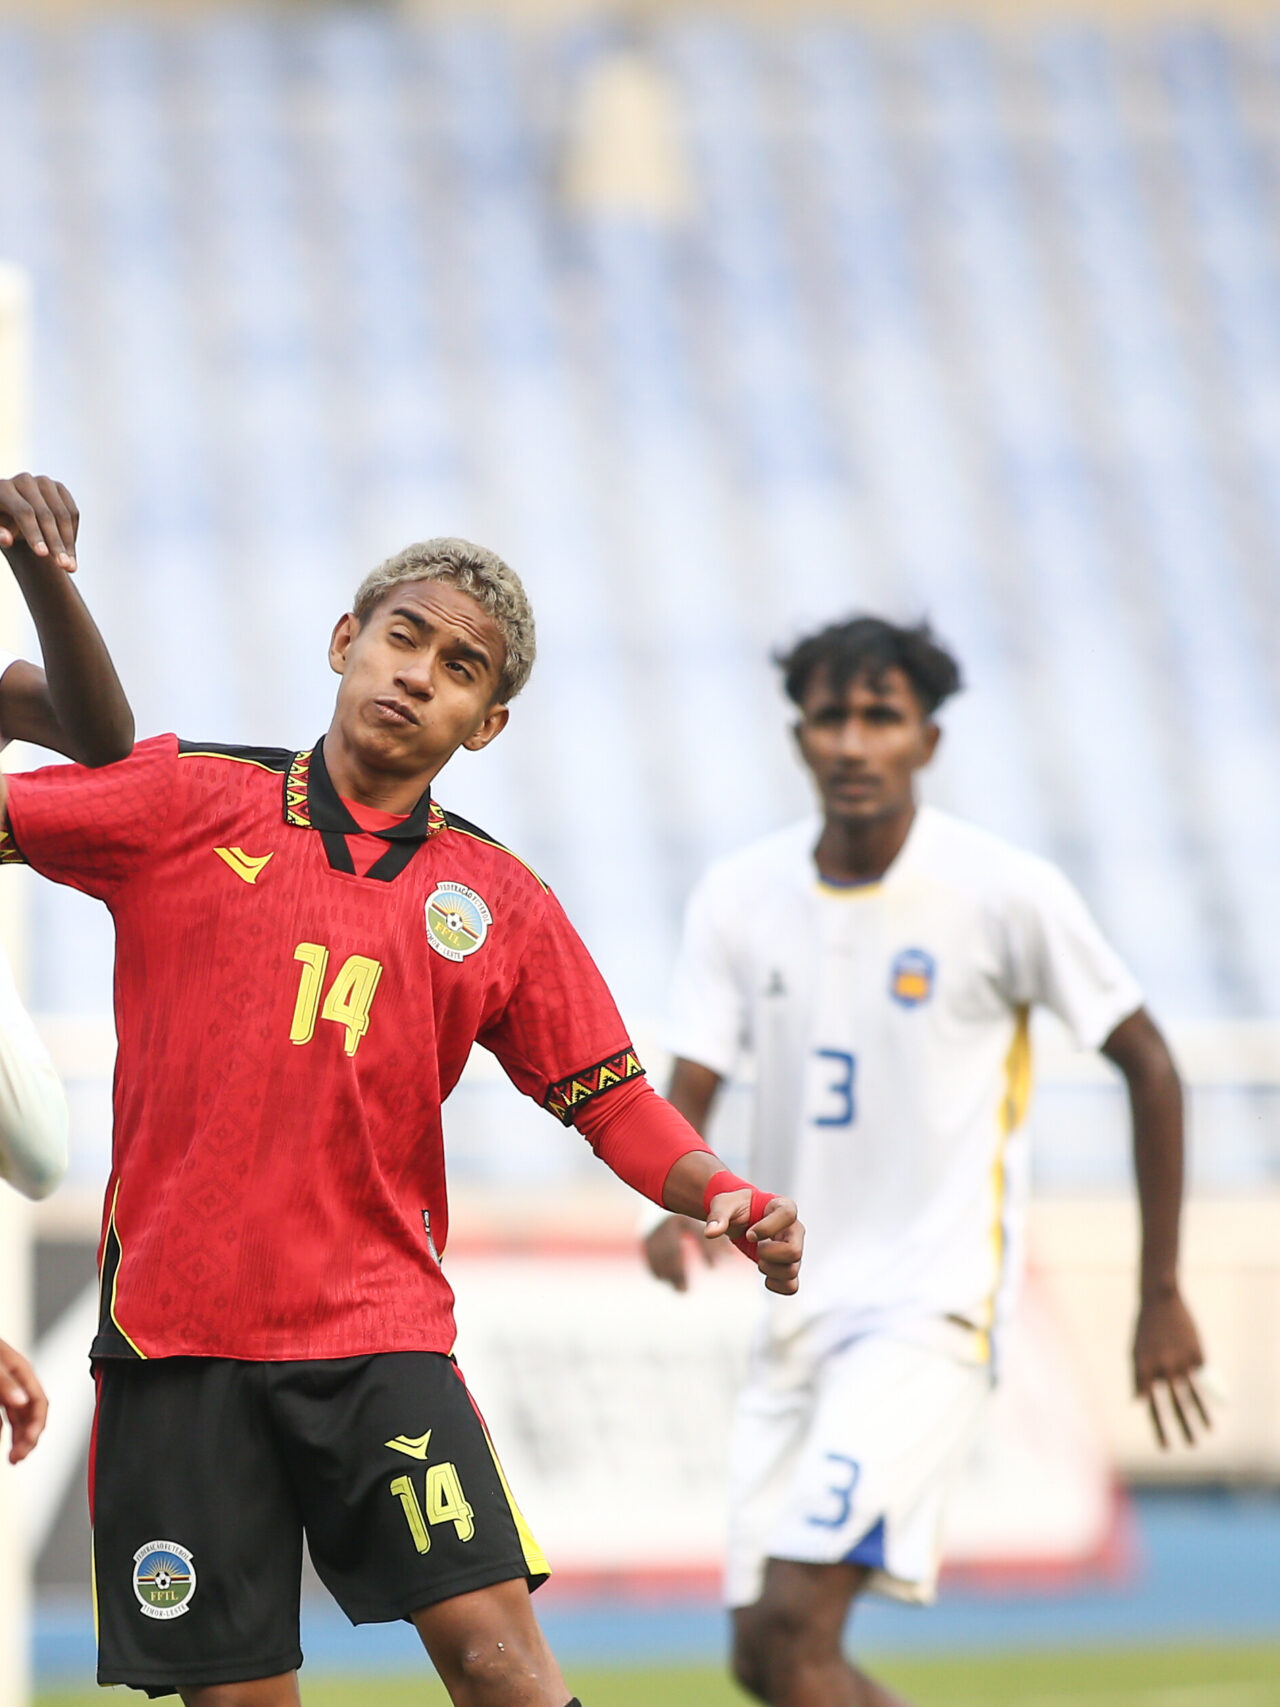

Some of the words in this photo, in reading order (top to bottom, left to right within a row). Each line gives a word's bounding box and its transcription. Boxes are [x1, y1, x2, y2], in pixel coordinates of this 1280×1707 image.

[289, 942, 383, 1057] 14
[813, 1047, 856, 1128] 3
[390, 1462, 474, 1555] 14
[806, 1452, 860, 1530] 3
[150, 1590, 178, 1601] FFTL
